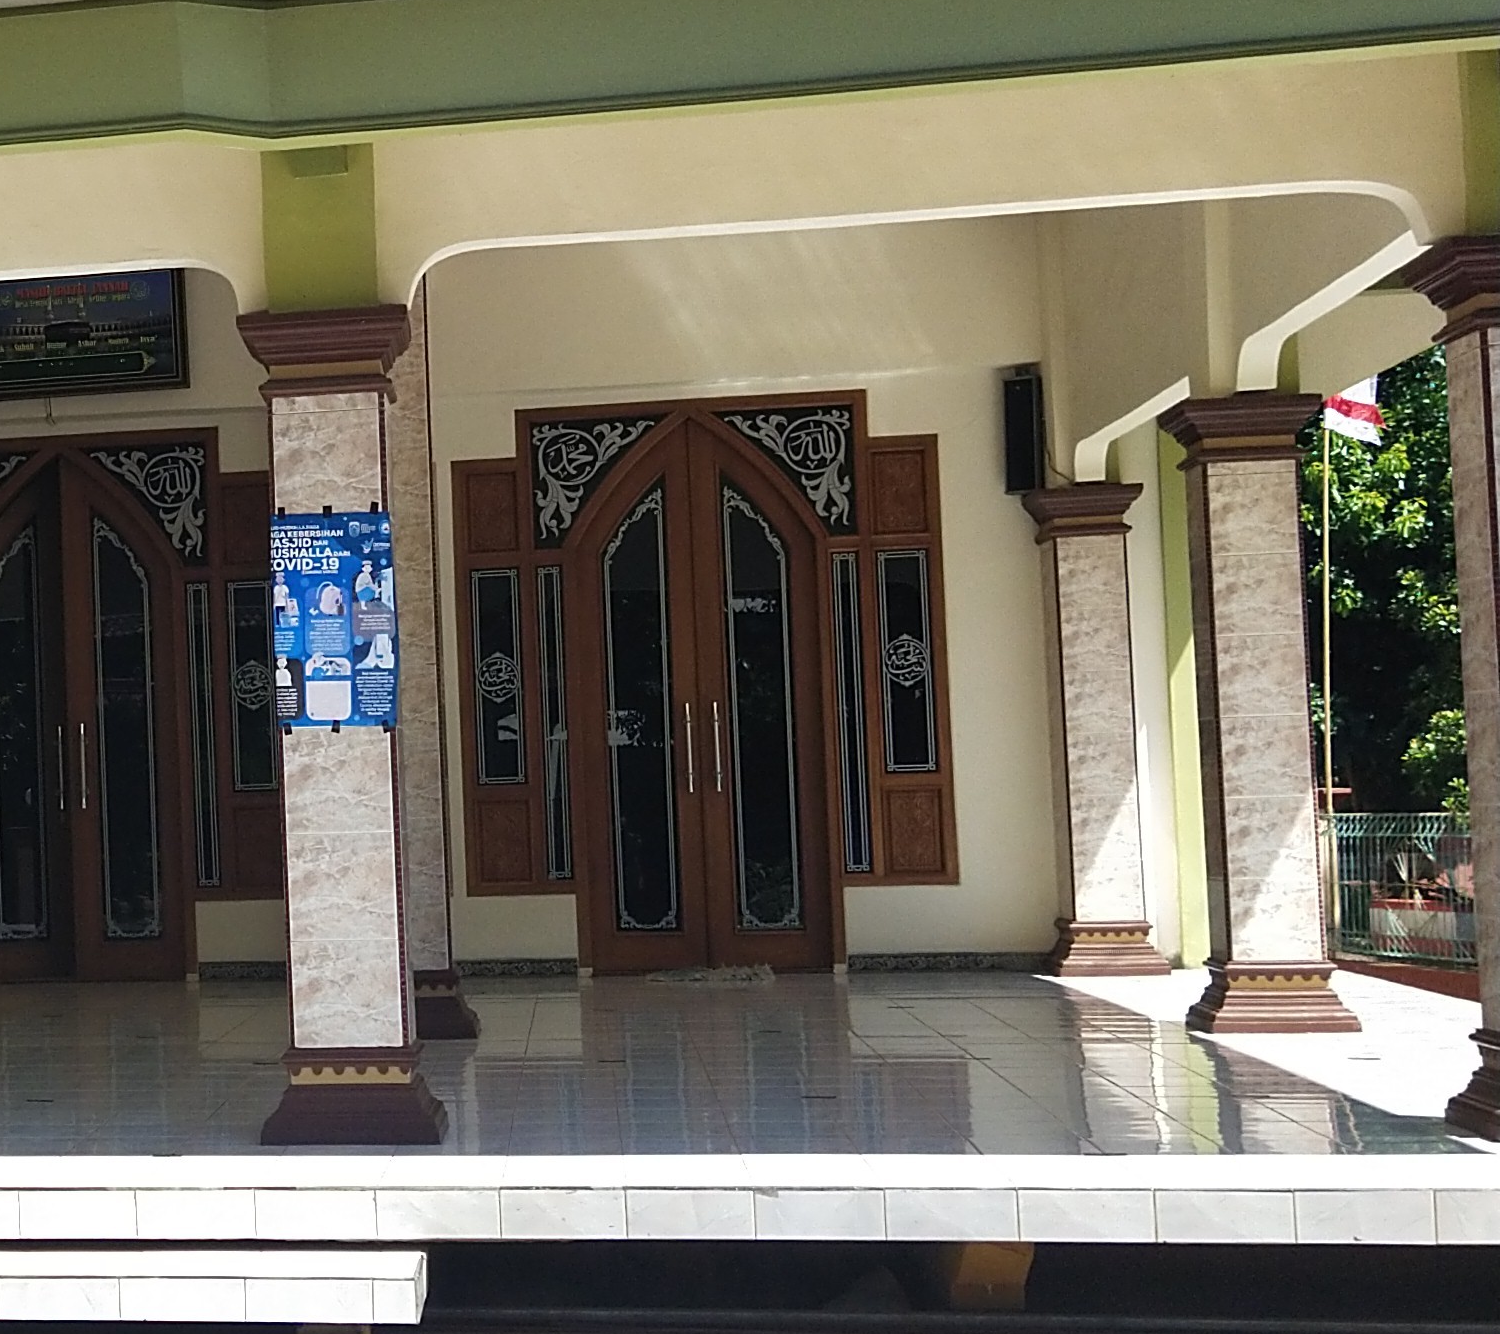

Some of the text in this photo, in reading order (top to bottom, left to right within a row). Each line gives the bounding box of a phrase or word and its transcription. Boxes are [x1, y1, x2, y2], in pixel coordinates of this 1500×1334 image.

[287, 529, 344, 538] KEBERSIHAN
[270, 537, 312, 548] ASJID
[270, 547, 333, 558] USHALLA
